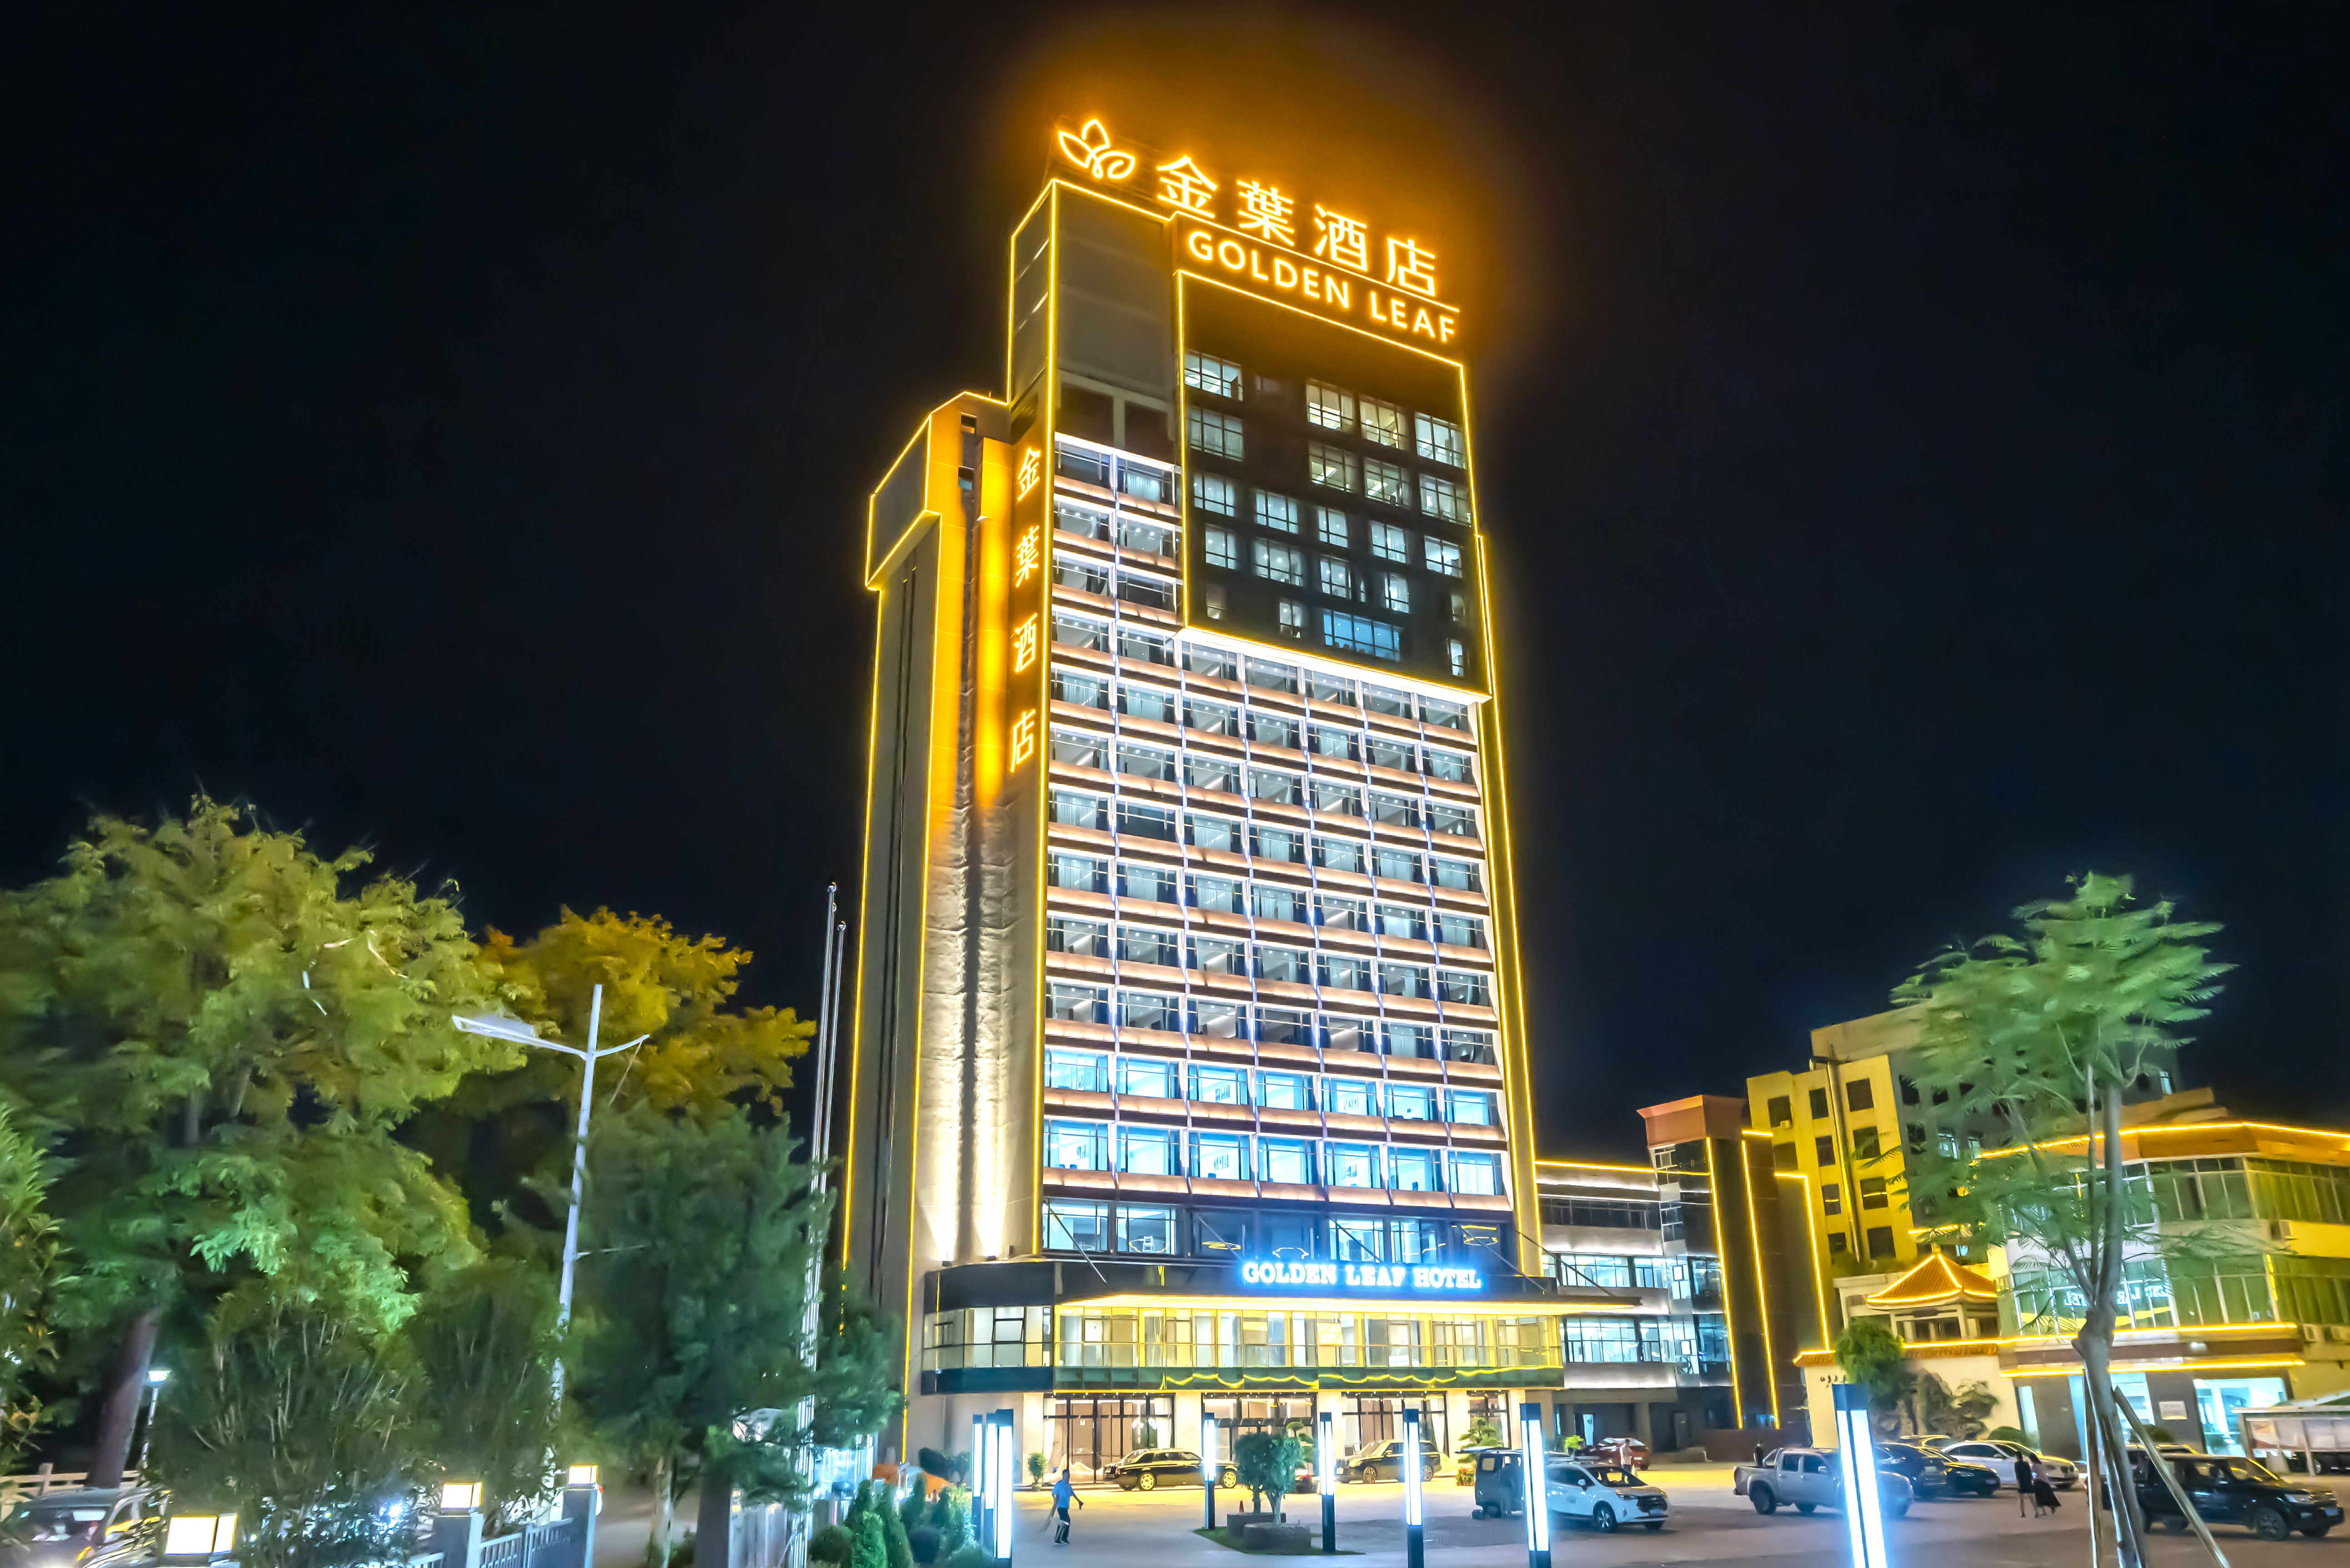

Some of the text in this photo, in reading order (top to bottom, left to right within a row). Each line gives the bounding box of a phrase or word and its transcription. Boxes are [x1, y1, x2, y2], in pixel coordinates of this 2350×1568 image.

[1155, 153, 1436, 298] 金葉酒店
[1187, 230, 1455, 343] GOLDEN LEAF
[1009, 446, 1042, 773] 金葉酒店
[1243, 1262, 1481, 1289] GOLDEN LEAF HOTEL
